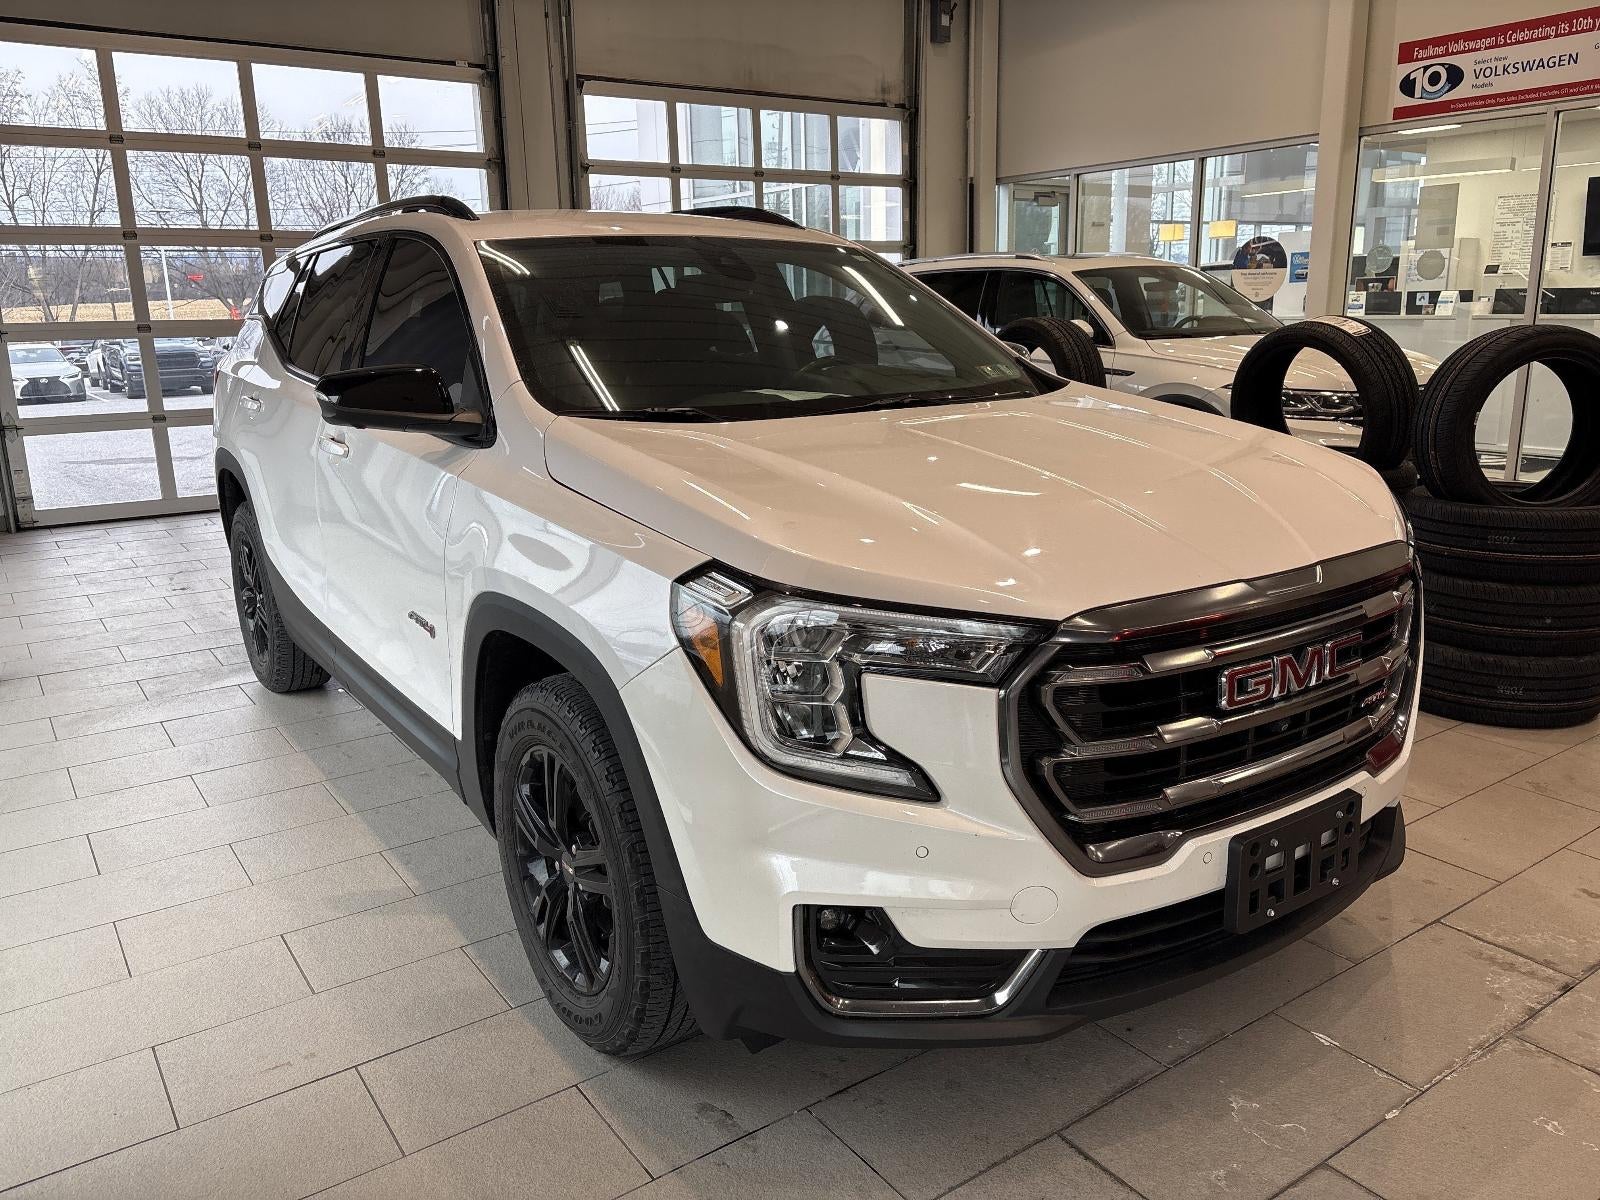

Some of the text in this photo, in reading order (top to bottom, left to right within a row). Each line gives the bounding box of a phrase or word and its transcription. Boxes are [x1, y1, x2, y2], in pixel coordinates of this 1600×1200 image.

[1413, 43, 1447, 59] Faulkner
[1448, 36, 1495, 53] Volkswagen
[1497, 32, 1504, 45] is
[1506, 24, 1556, 43] Celebrating
[1571, 16, 1593, 32] 10th
[1473, 55, 1508, 66] Select New
[1473, 52, 1579, 79] VOLKSWAGEN
[1409, 65, 1448, 99] 10
[1471, 81, 1494, 90] Models
[1218, 631, 1363, 711] GMC
